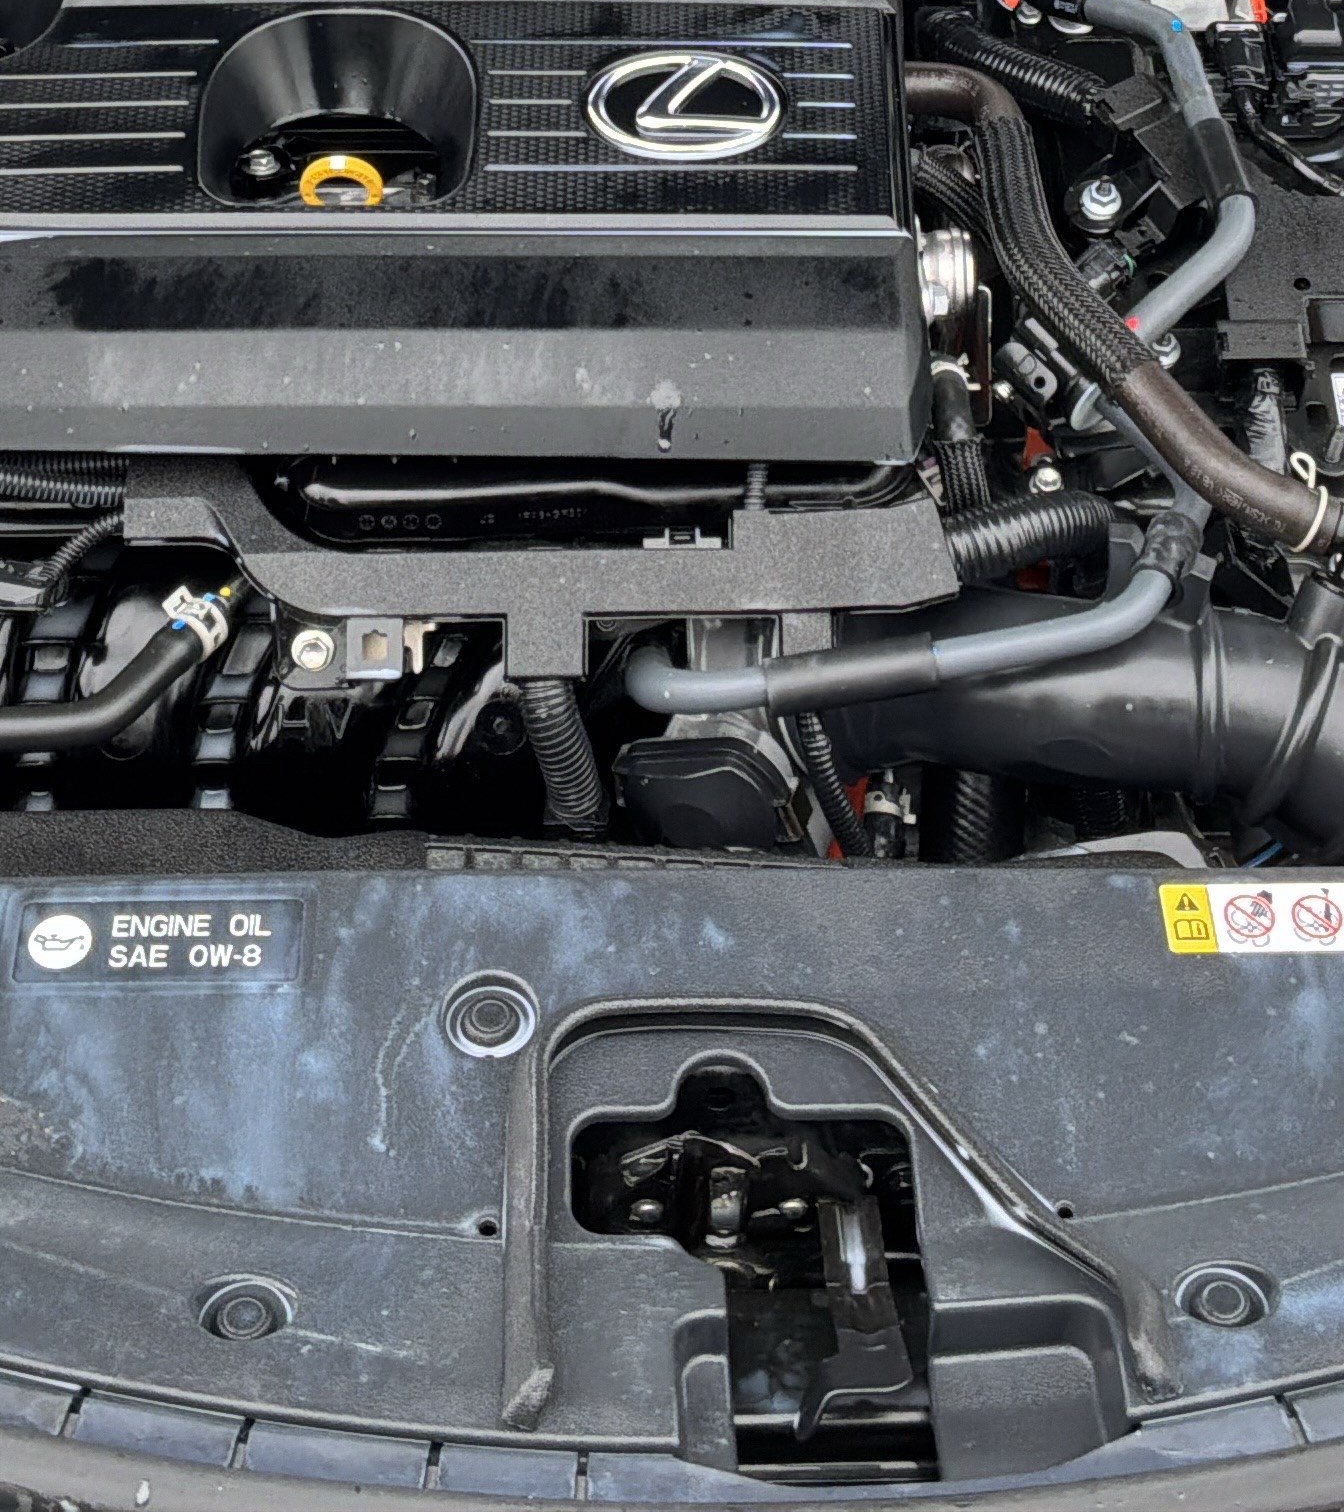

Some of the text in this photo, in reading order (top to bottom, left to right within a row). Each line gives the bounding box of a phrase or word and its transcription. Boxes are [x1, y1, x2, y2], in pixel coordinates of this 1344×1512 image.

[111, 913, 272, 938] ENGINE OIL
[108, 944, 262, 968] SAE 0W-8
